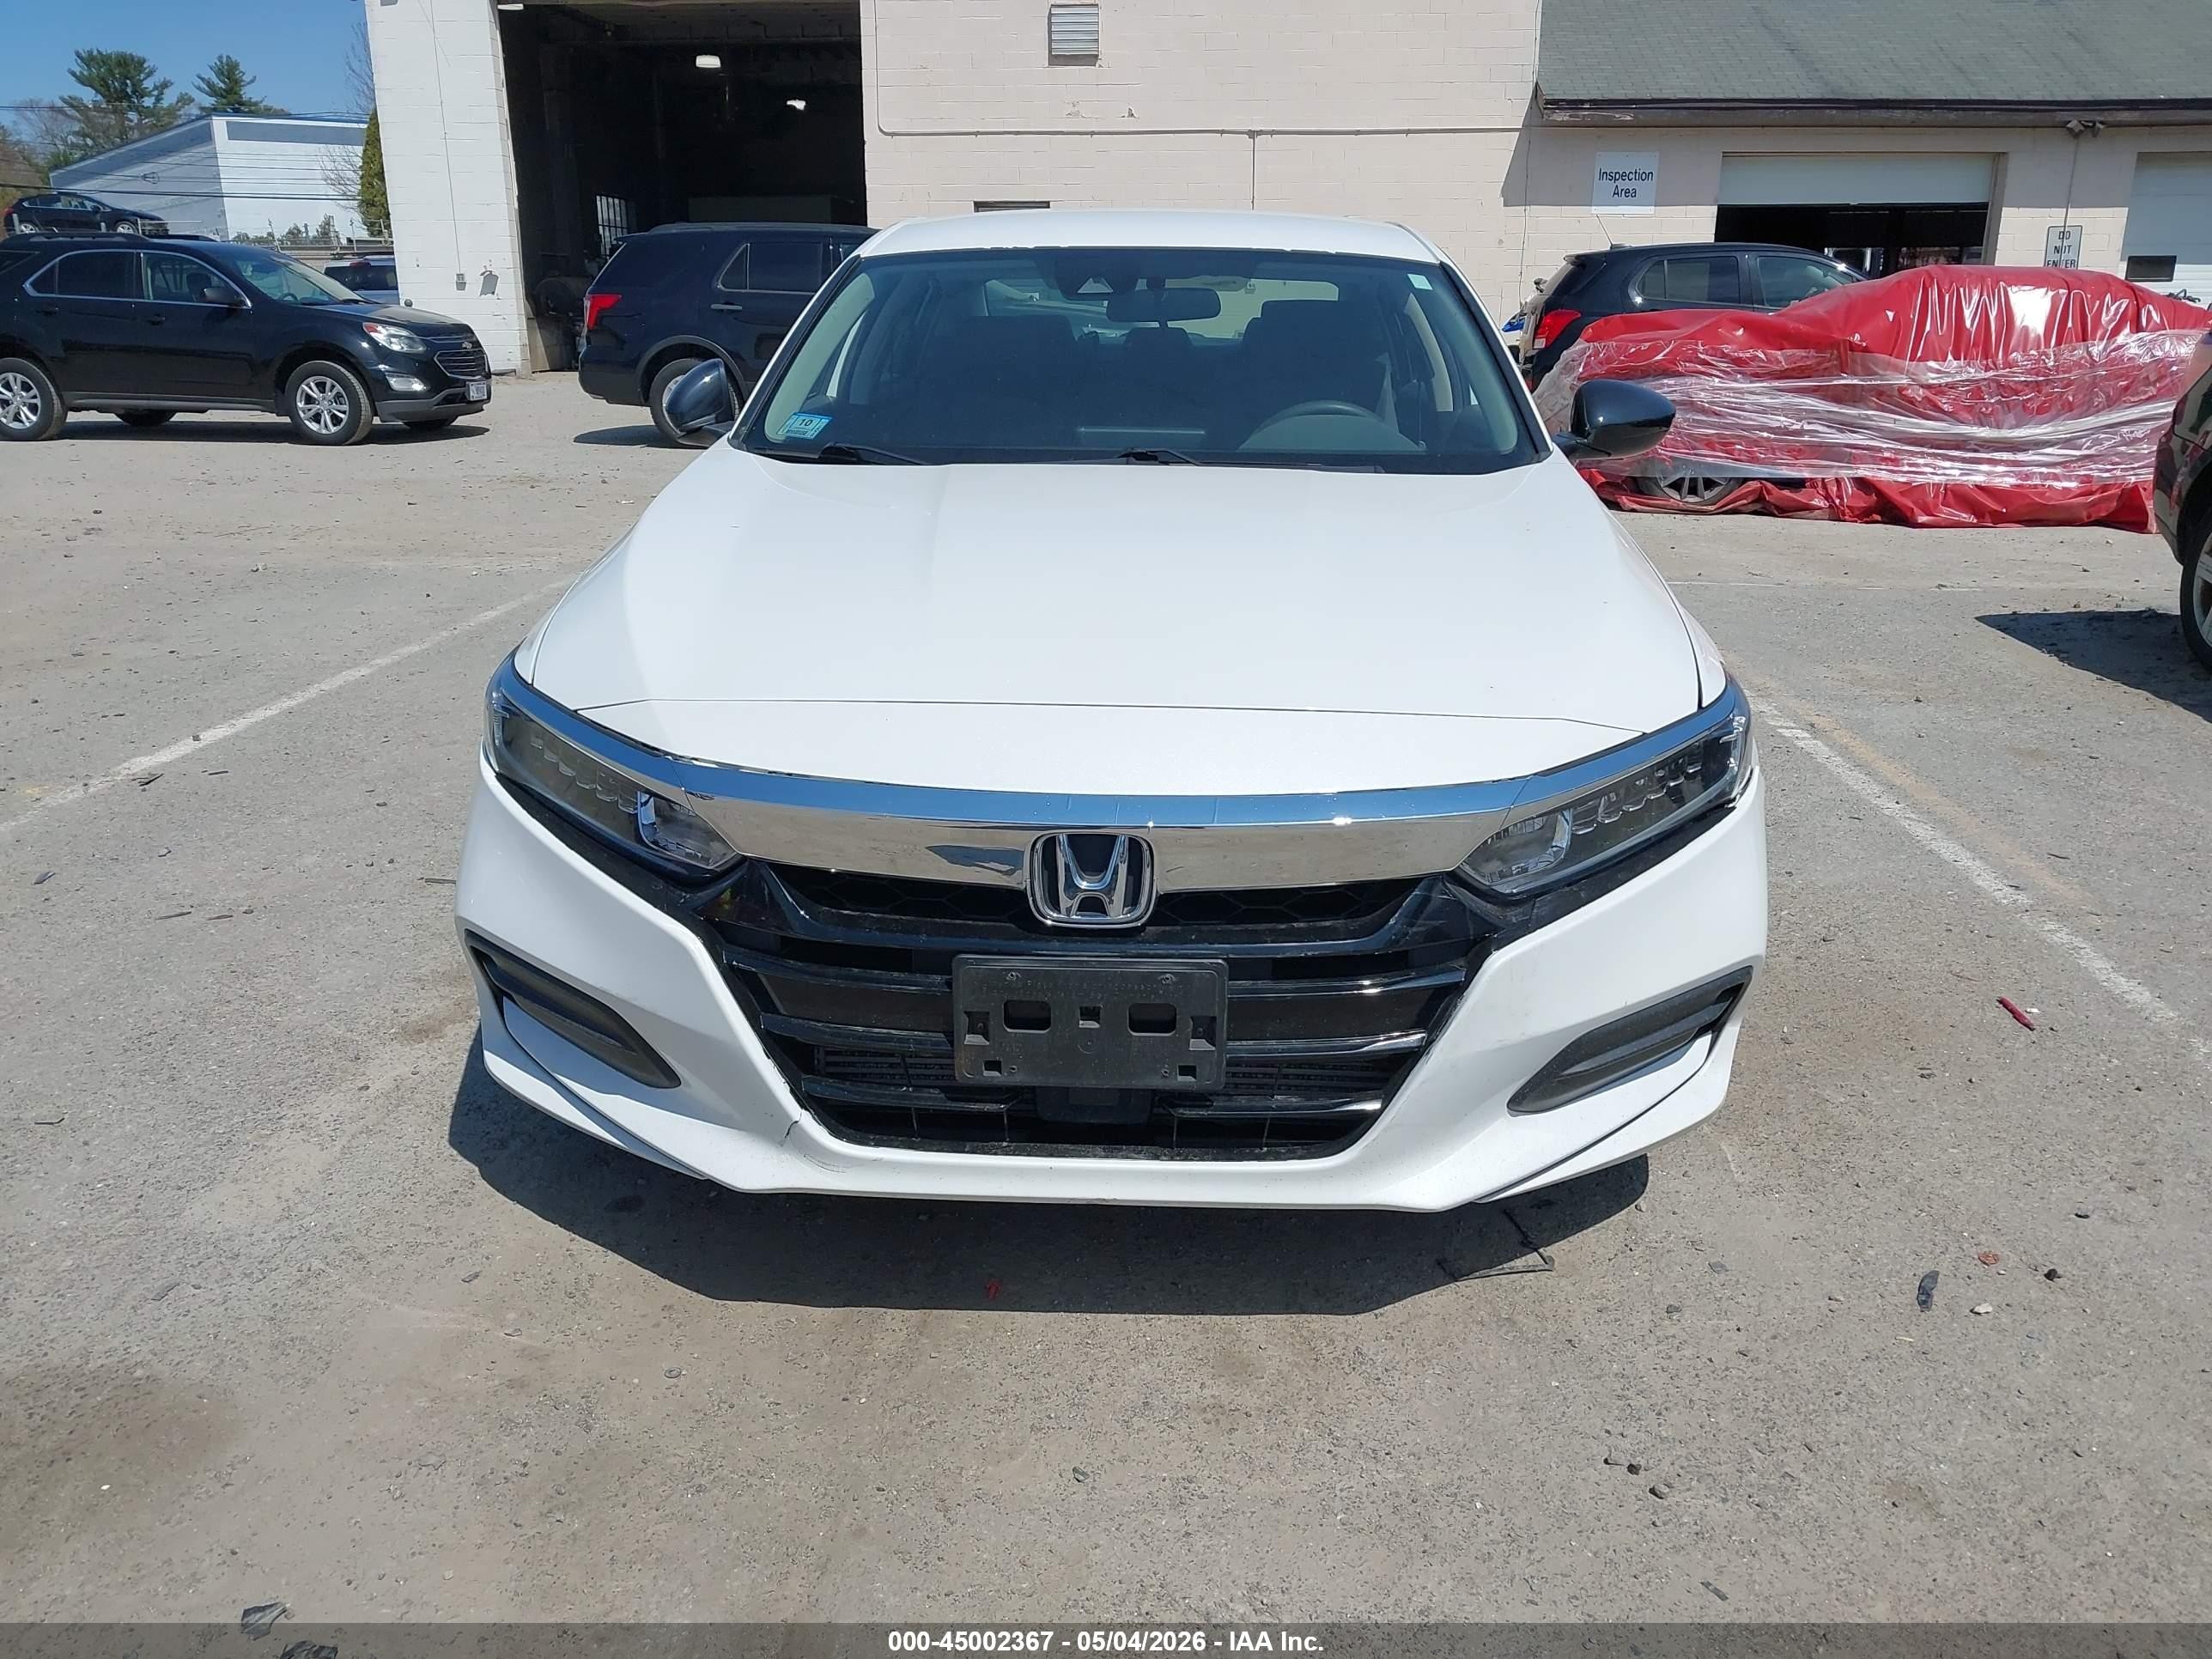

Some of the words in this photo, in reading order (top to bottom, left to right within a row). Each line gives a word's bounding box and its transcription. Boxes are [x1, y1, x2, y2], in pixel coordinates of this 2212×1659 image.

[1598, 167, 1654, 183] Inspection
[1613, 185, 1637, 198] Area
[2058, 230, 2071, 240] DO
[799, 418, 813, 427] 10
